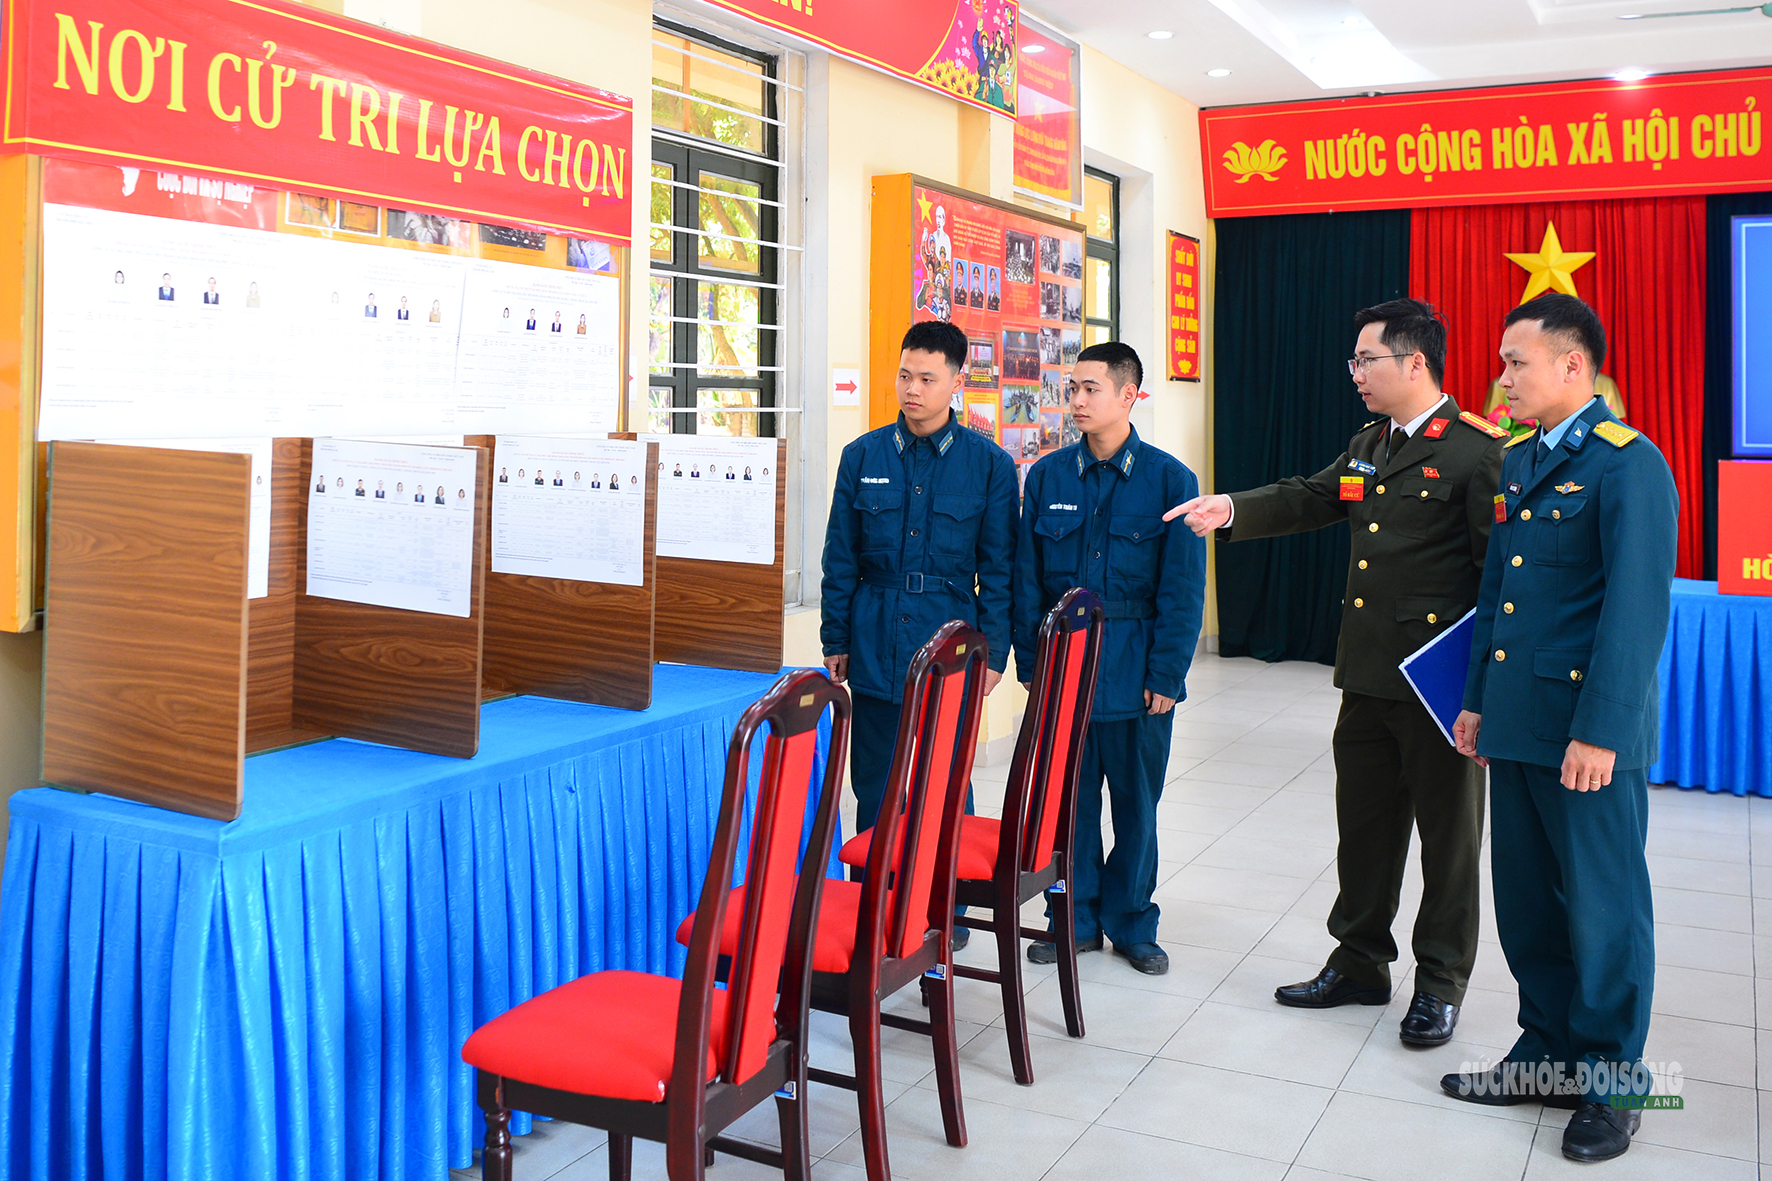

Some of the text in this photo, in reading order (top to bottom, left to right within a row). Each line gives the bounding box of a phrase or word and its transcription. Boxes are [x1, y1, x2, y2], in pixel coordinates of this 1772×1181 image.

[54, 13, 626, 208] NƠI CỬ TRI LỰA CHỌN
[1304, 96, 1762, 183] NƯỚC CỘNG HÒA XÃ HỘI CHỦ
